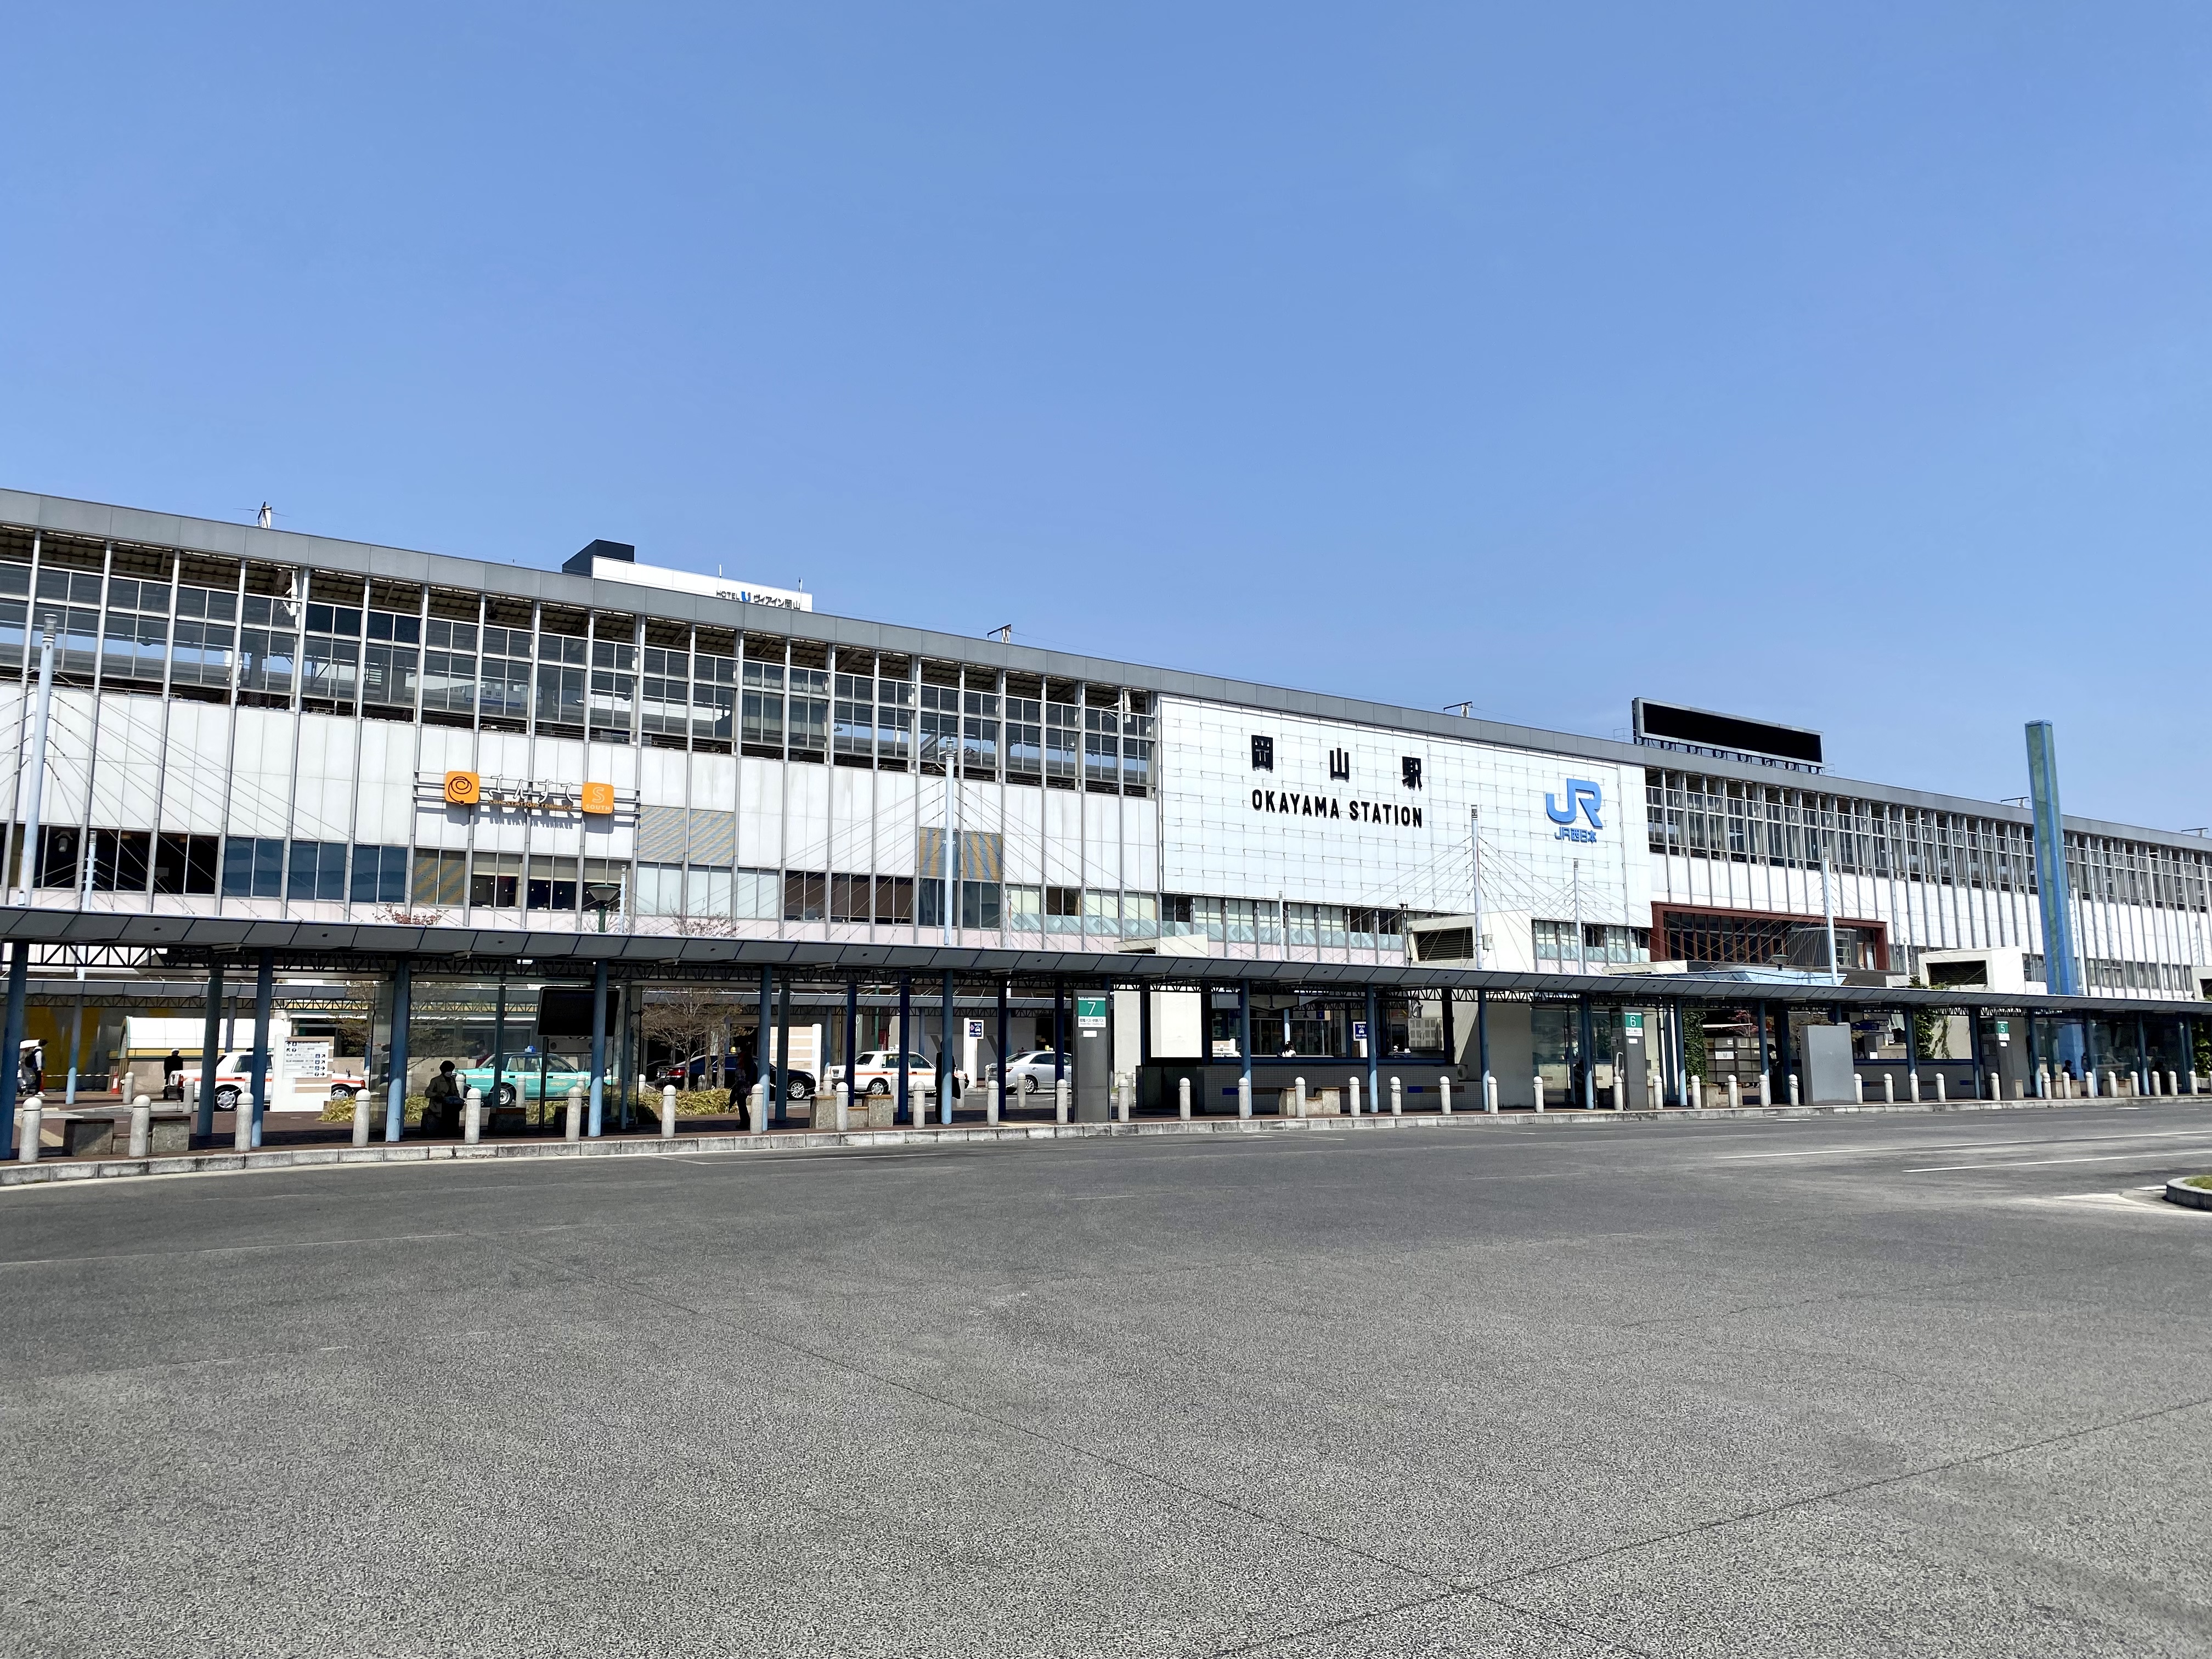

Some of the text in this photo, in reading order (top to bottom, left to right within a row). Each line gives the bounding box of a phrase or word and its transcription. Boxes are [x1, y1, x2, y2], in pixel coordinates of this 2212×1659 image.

[716, 590, 740, 600] HOTEL
[754, 594, 800, 610] ヴィアイン岡山
[1251, 735, 1422, 791] 岡山駅
[488, 774, 574, 804] さんすて
[1252, 789, 1422, 828] OKAYAMA STATION
[1545, 778, 1603, 830] JR
[1554, 826, 1597, 844] JR西日本
[1087, 1001, 1096, 1015] 7
[1630, 1015, 1637, 1027] 6
[2000, 1024, 2006, 1033] 5
